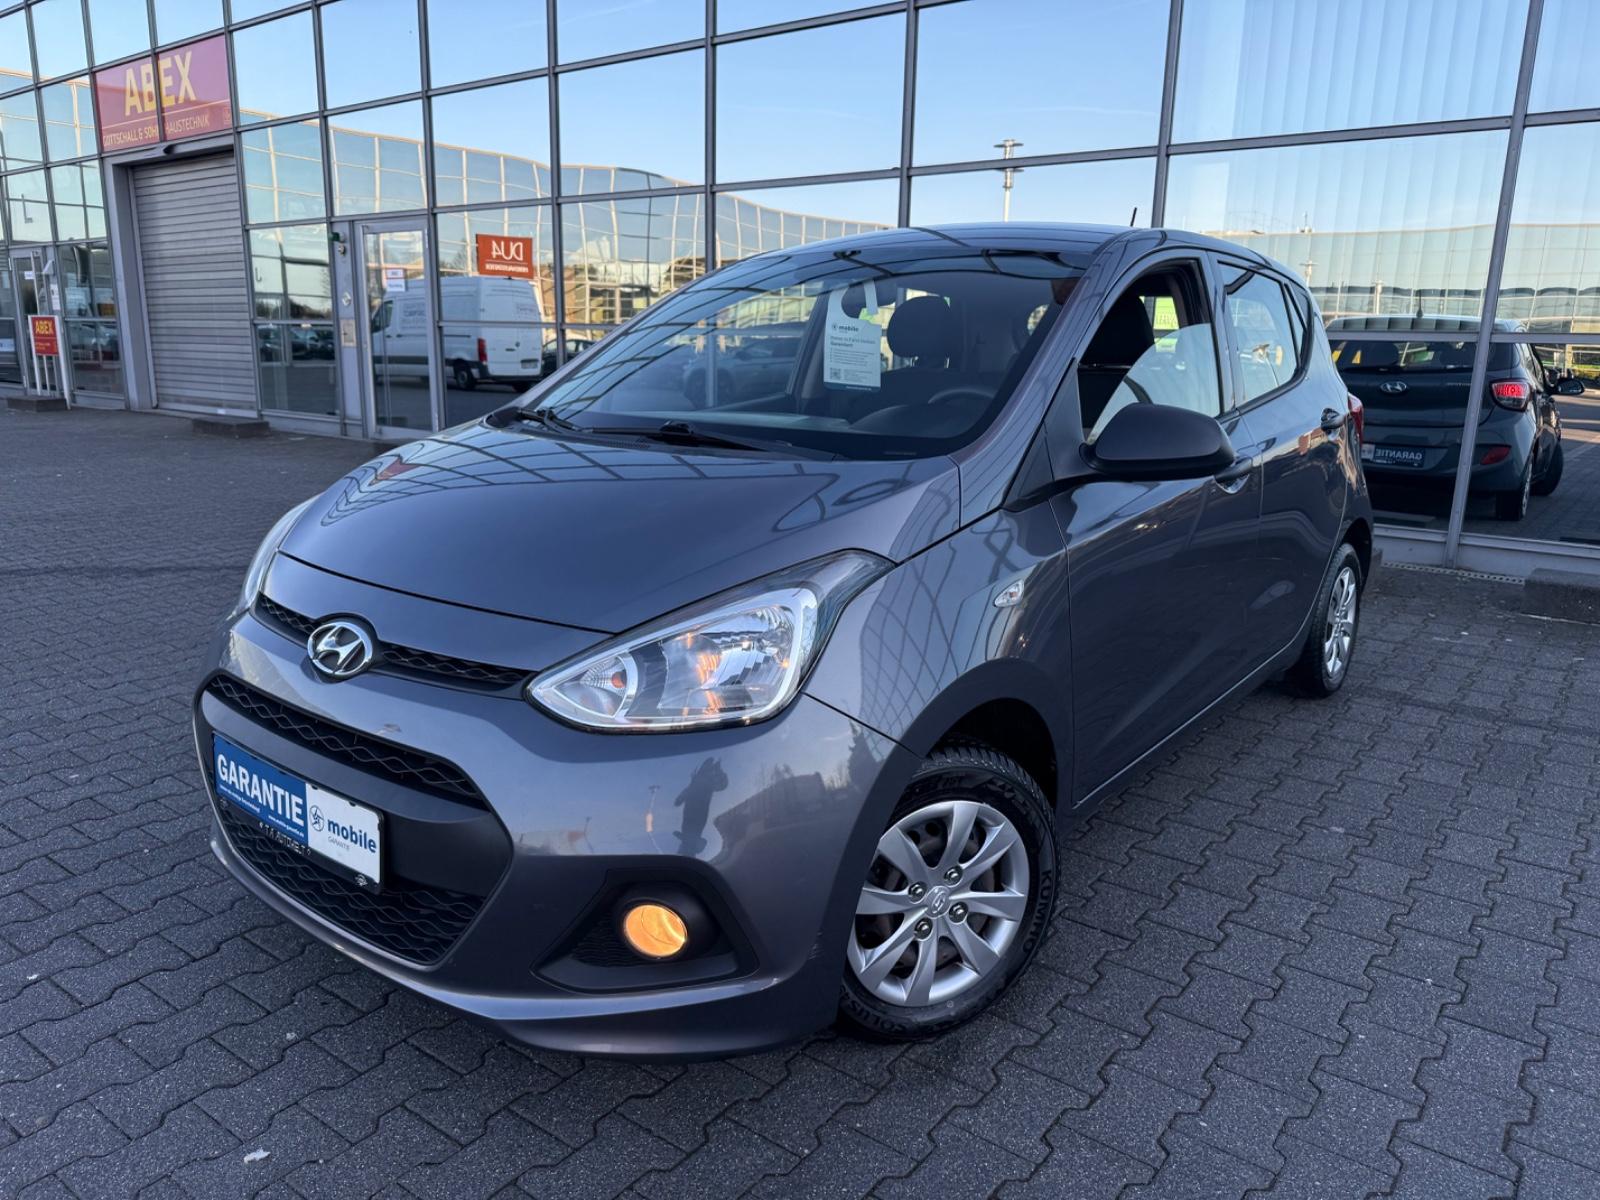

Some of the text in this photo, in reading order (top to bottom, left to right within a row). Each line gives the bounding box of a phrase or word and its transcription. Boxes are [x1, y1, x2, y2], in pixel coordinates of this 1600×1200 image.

[125, 51, 196, 116] ABEX
[35, 320, 54, 334] ABEX
[217, 754, 304, 827] GARANTIE
[327, 819, 376, 853] mobile
[1022, 869, 1052, 953] KUMHO
